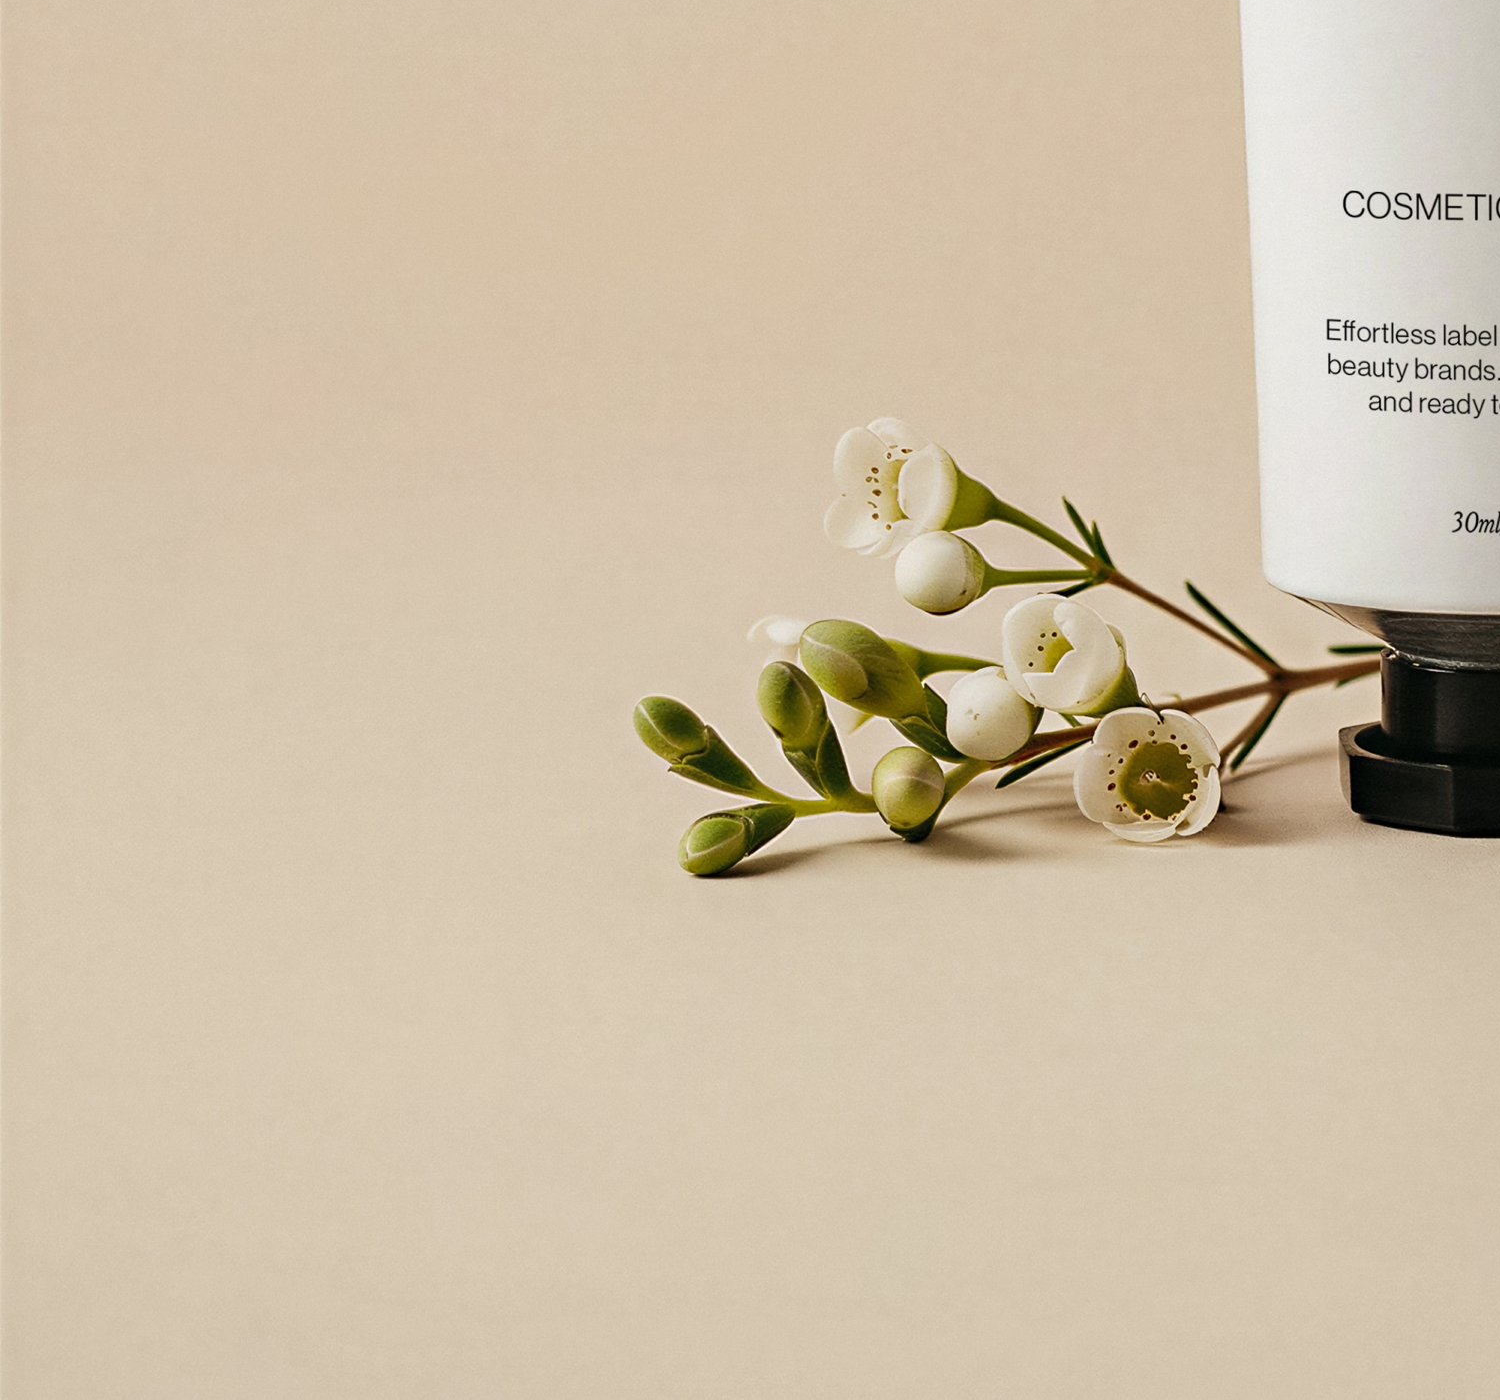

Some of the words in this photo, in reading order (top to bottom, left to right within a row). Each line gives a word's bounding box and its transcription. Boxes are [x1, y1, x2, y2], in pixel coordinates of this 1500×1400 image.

[1326, 318, 1437, 346] Effortless
[1442, 323, 1498, 347] label
[1327, 352, 1409, 383] beauty
[1368, 390, 1413, 414] and
[1418, 392, 1486, 419] ready
